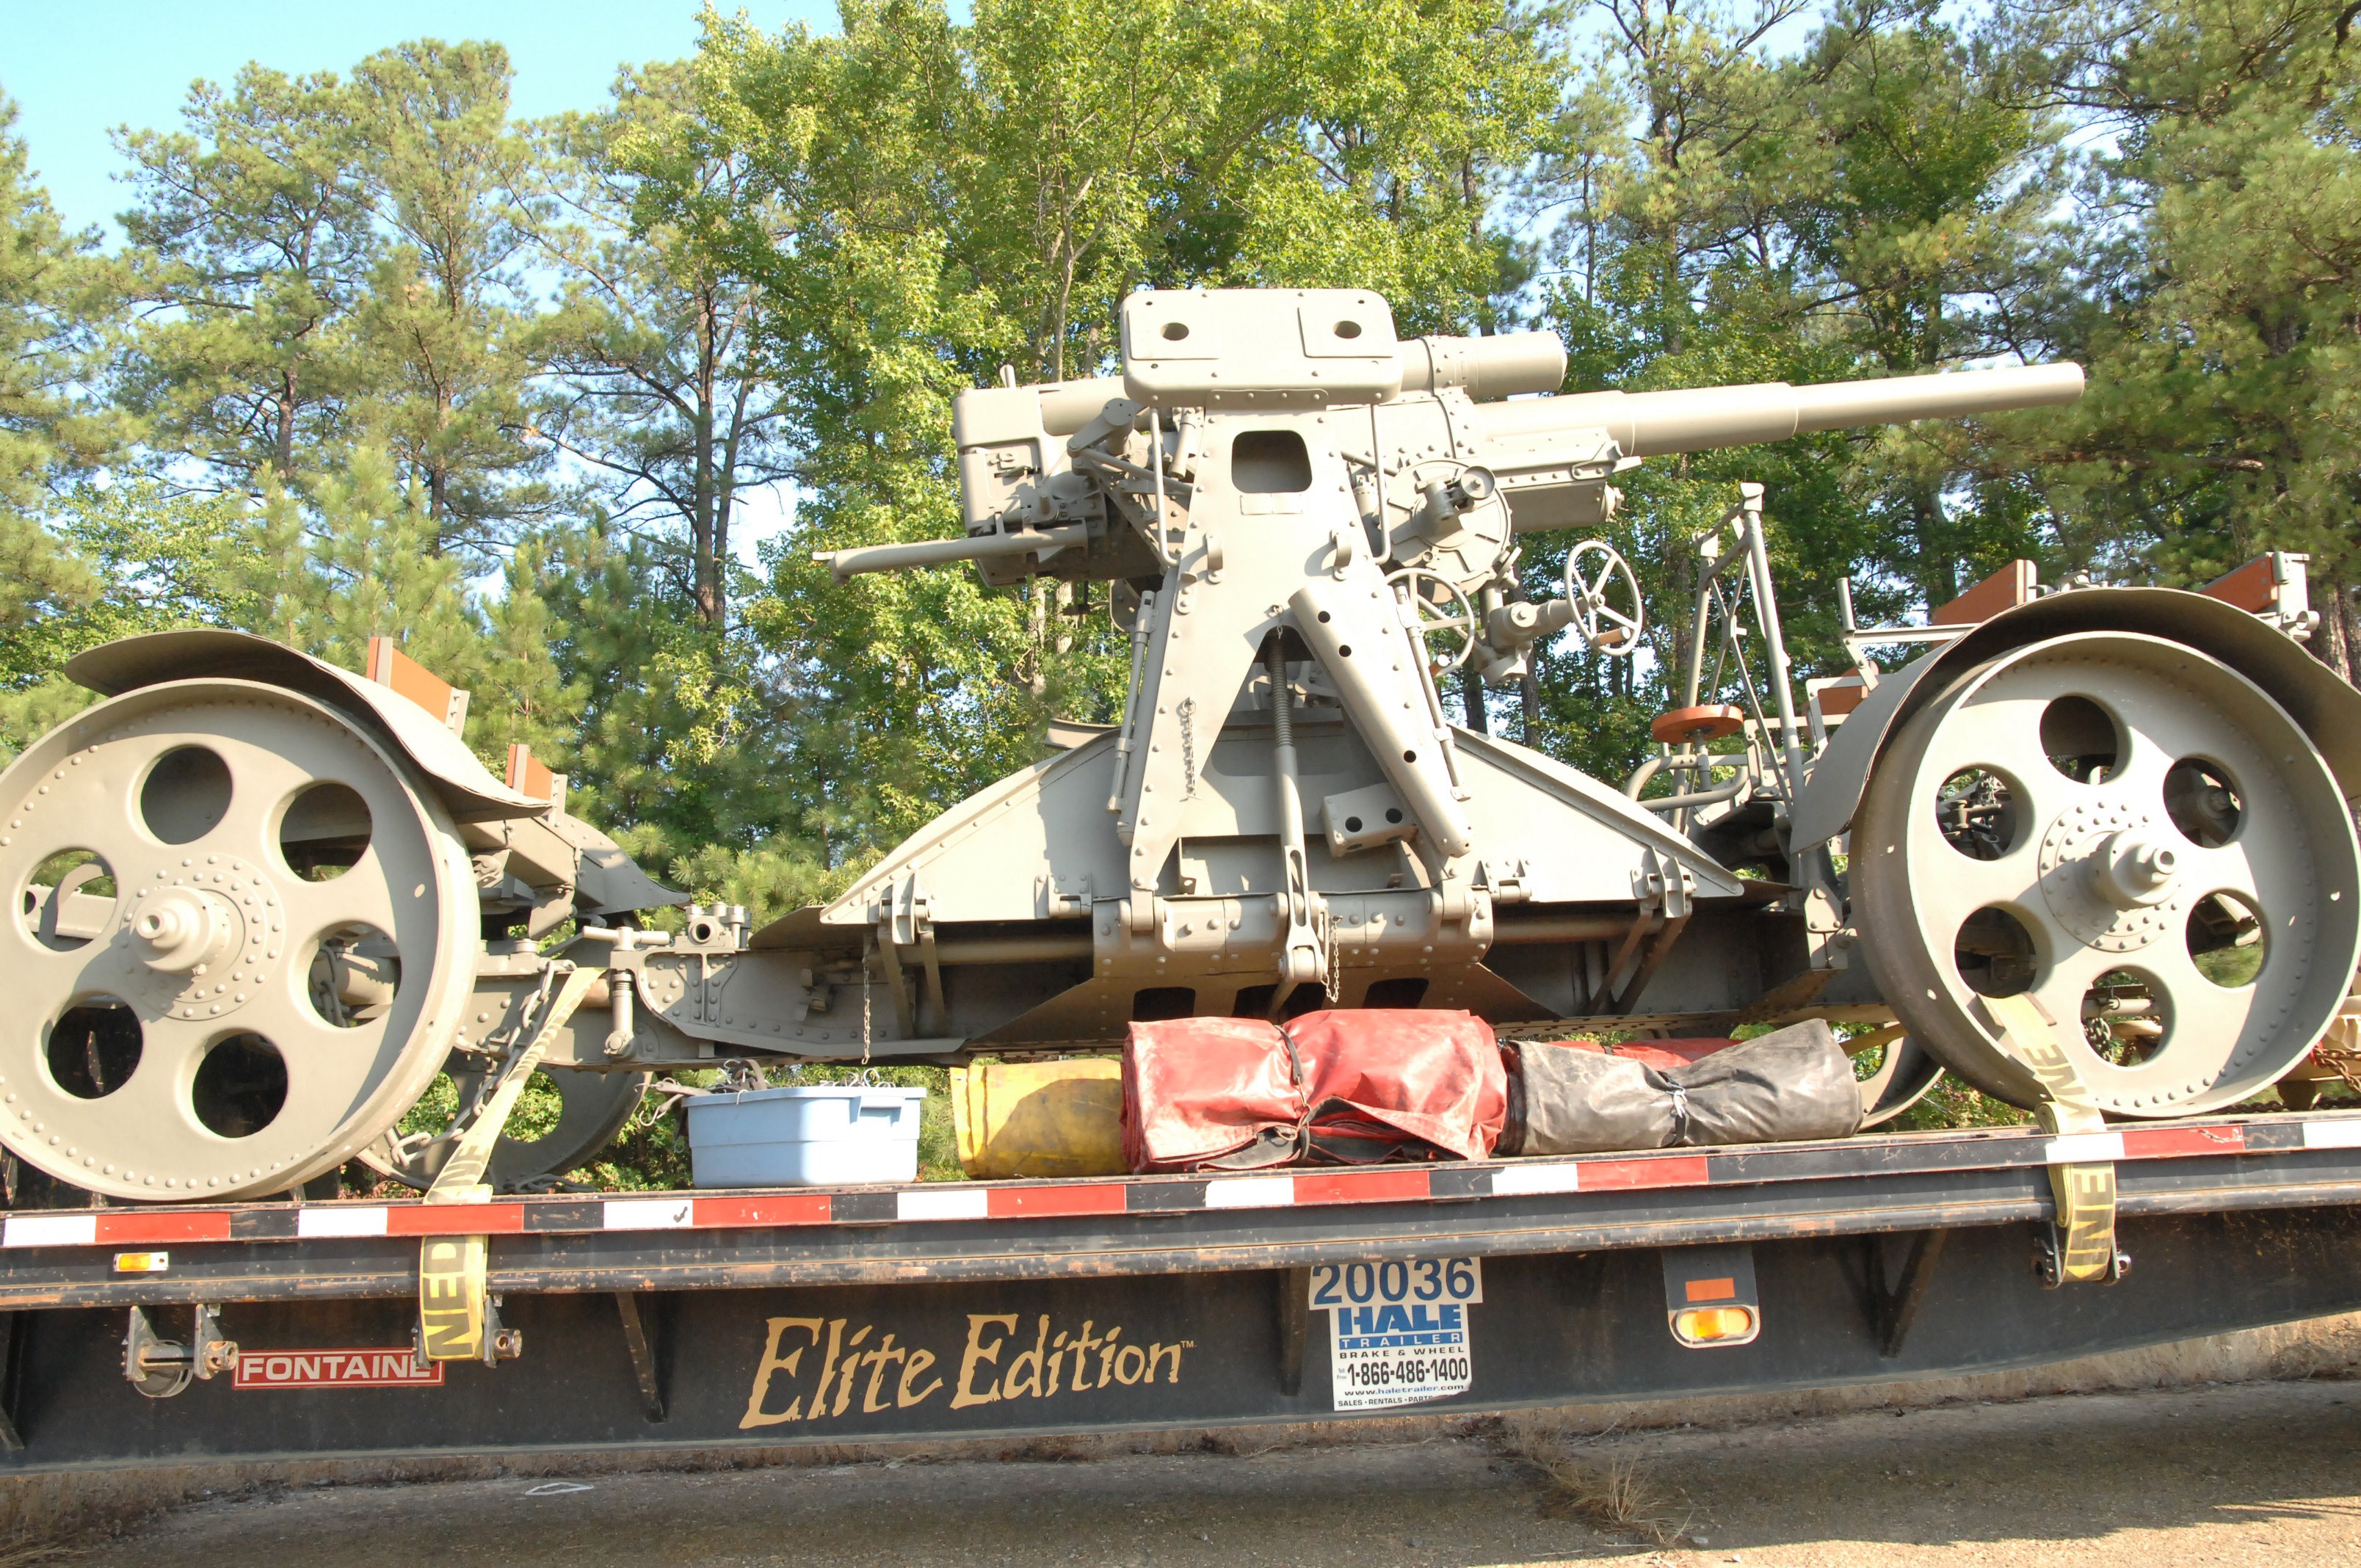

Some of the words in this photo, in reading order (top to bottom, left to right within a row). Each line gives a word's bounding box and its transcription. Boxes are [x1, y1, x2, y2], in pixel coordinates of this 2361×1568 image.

[1312, 1257, 1475, 1305] 20036
[1338, 1304, 1462, 1335] HALE
[1340, 1350, 1390, 1359] BRAKE
[1398, 1348, 1406, 1356] &
[1414, 1346, 1465, 1356] WHEEL
[1341, 1332, 1461, 1349] TRAILER
[242, 1355, 431, 1381] FONTAINE
[739, 1317, 943, 1429] Elite
[950, 1313, 1181, 1409] Edition
[1347, 1358, 1468, 1386] 1-866-486-1400
[1344, 1384, 1465, 1396] www.haletrailer.com
[1368, 1397, 1403, 1405] RENTALS
